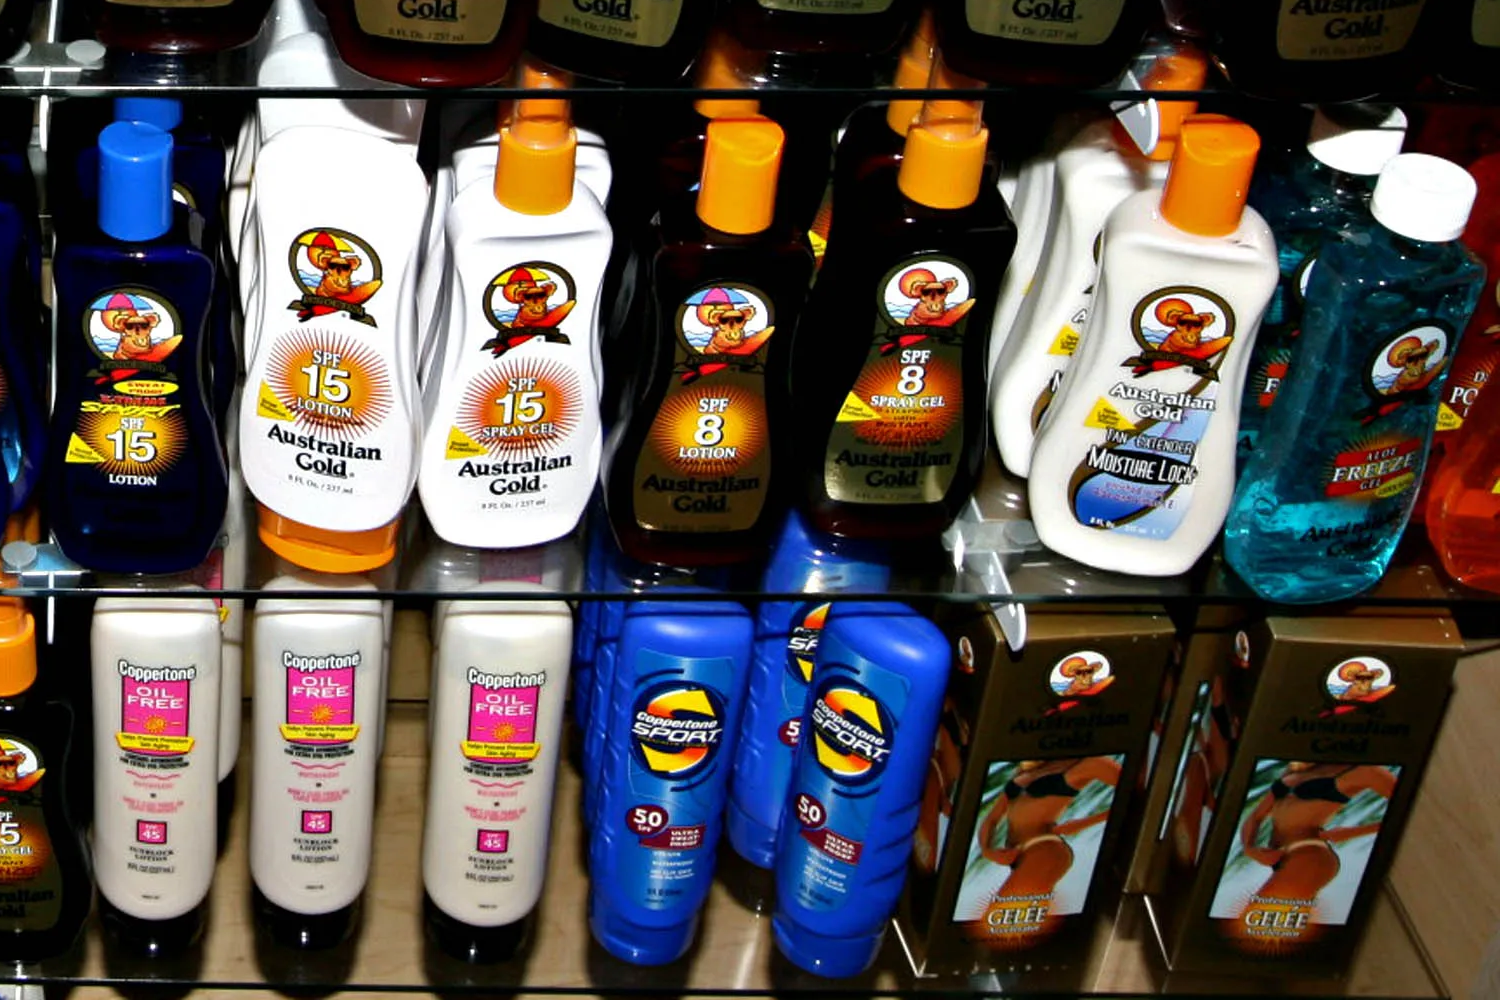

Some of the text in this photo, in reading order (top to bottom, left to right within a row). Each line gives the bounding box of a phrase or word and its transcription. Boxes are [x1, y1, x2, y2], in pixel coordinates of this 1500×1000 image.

[301, 364, 351, 402] 15
[297, 397, 353, 418] LOTION
[870, 395, 945, 408] SPRAY GEL
[106, 430, 156, 463] 15
[1107, 428, 1127, 444] TAN
[1088, 445, 1194, 484] MOISTURE LOCK
[1332, 454, 1415, 482] FREEZE
[118, 659, 196, 683] Coppertone
[127, 696, 184, 710] FREE
[137, 687, 173, 698] OIL
[636, 711, 718, 730] Coppertone
[631, 722, 723, 744] SPORT
[632, 810, 662, 827] 50
[141, 828, 161, 841] 45
[988, 904, 1049, 927] GELÉE
[1244, 906, 1309, 930] GELÉE
